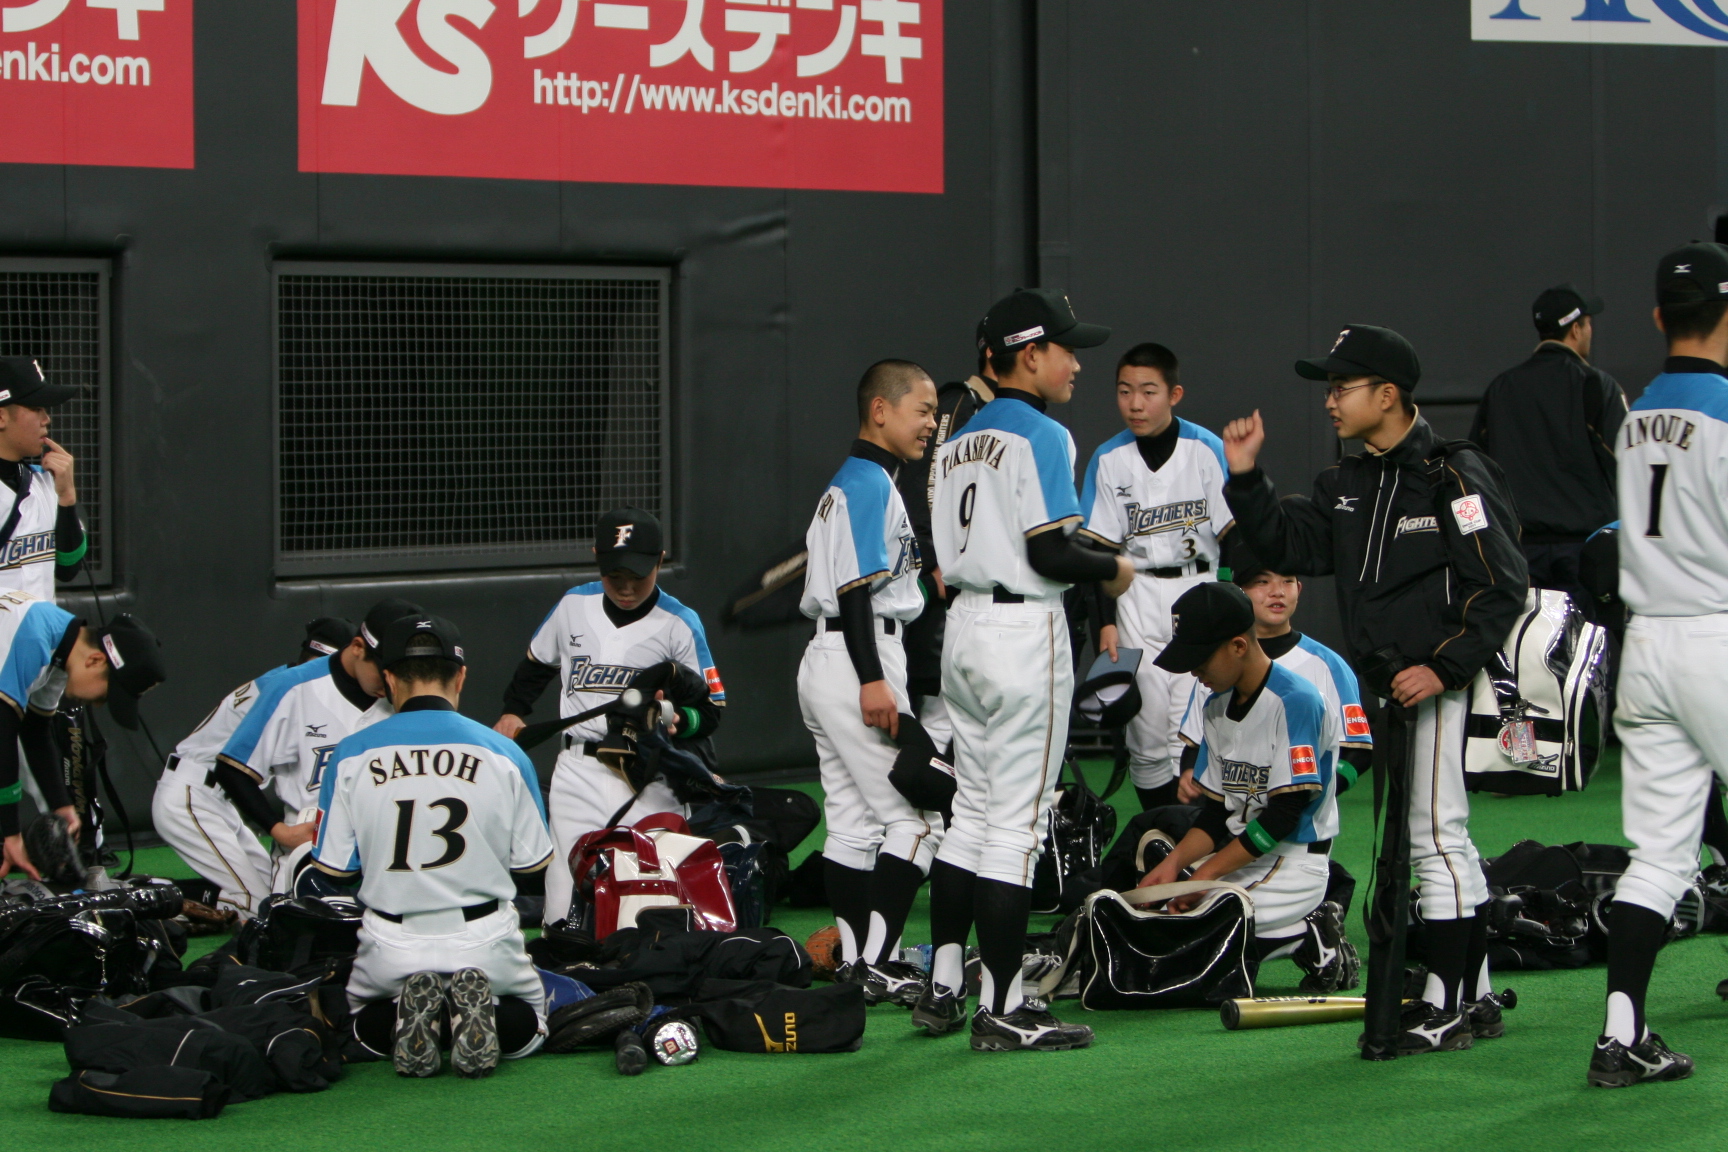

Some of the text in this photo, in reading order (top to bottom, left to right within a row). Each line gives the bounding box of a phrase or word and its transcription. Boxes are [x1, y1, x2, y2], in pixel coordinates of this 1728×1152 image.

[0, 42, 150, 86] nki.com
[533, 68, 911, 122] http://www.ksdenki.com
[1624, 414, 1695, 451] INOUE
[613, 524, 634, 548] F
[959, 482, 977, 554] 9
[1123, 499, 1207, 540] FIGHTERS
[1182, 538, 1196, 559] 3
[369, 749, 483, 786] SATOH
[384, 797, 469, 872] 13
